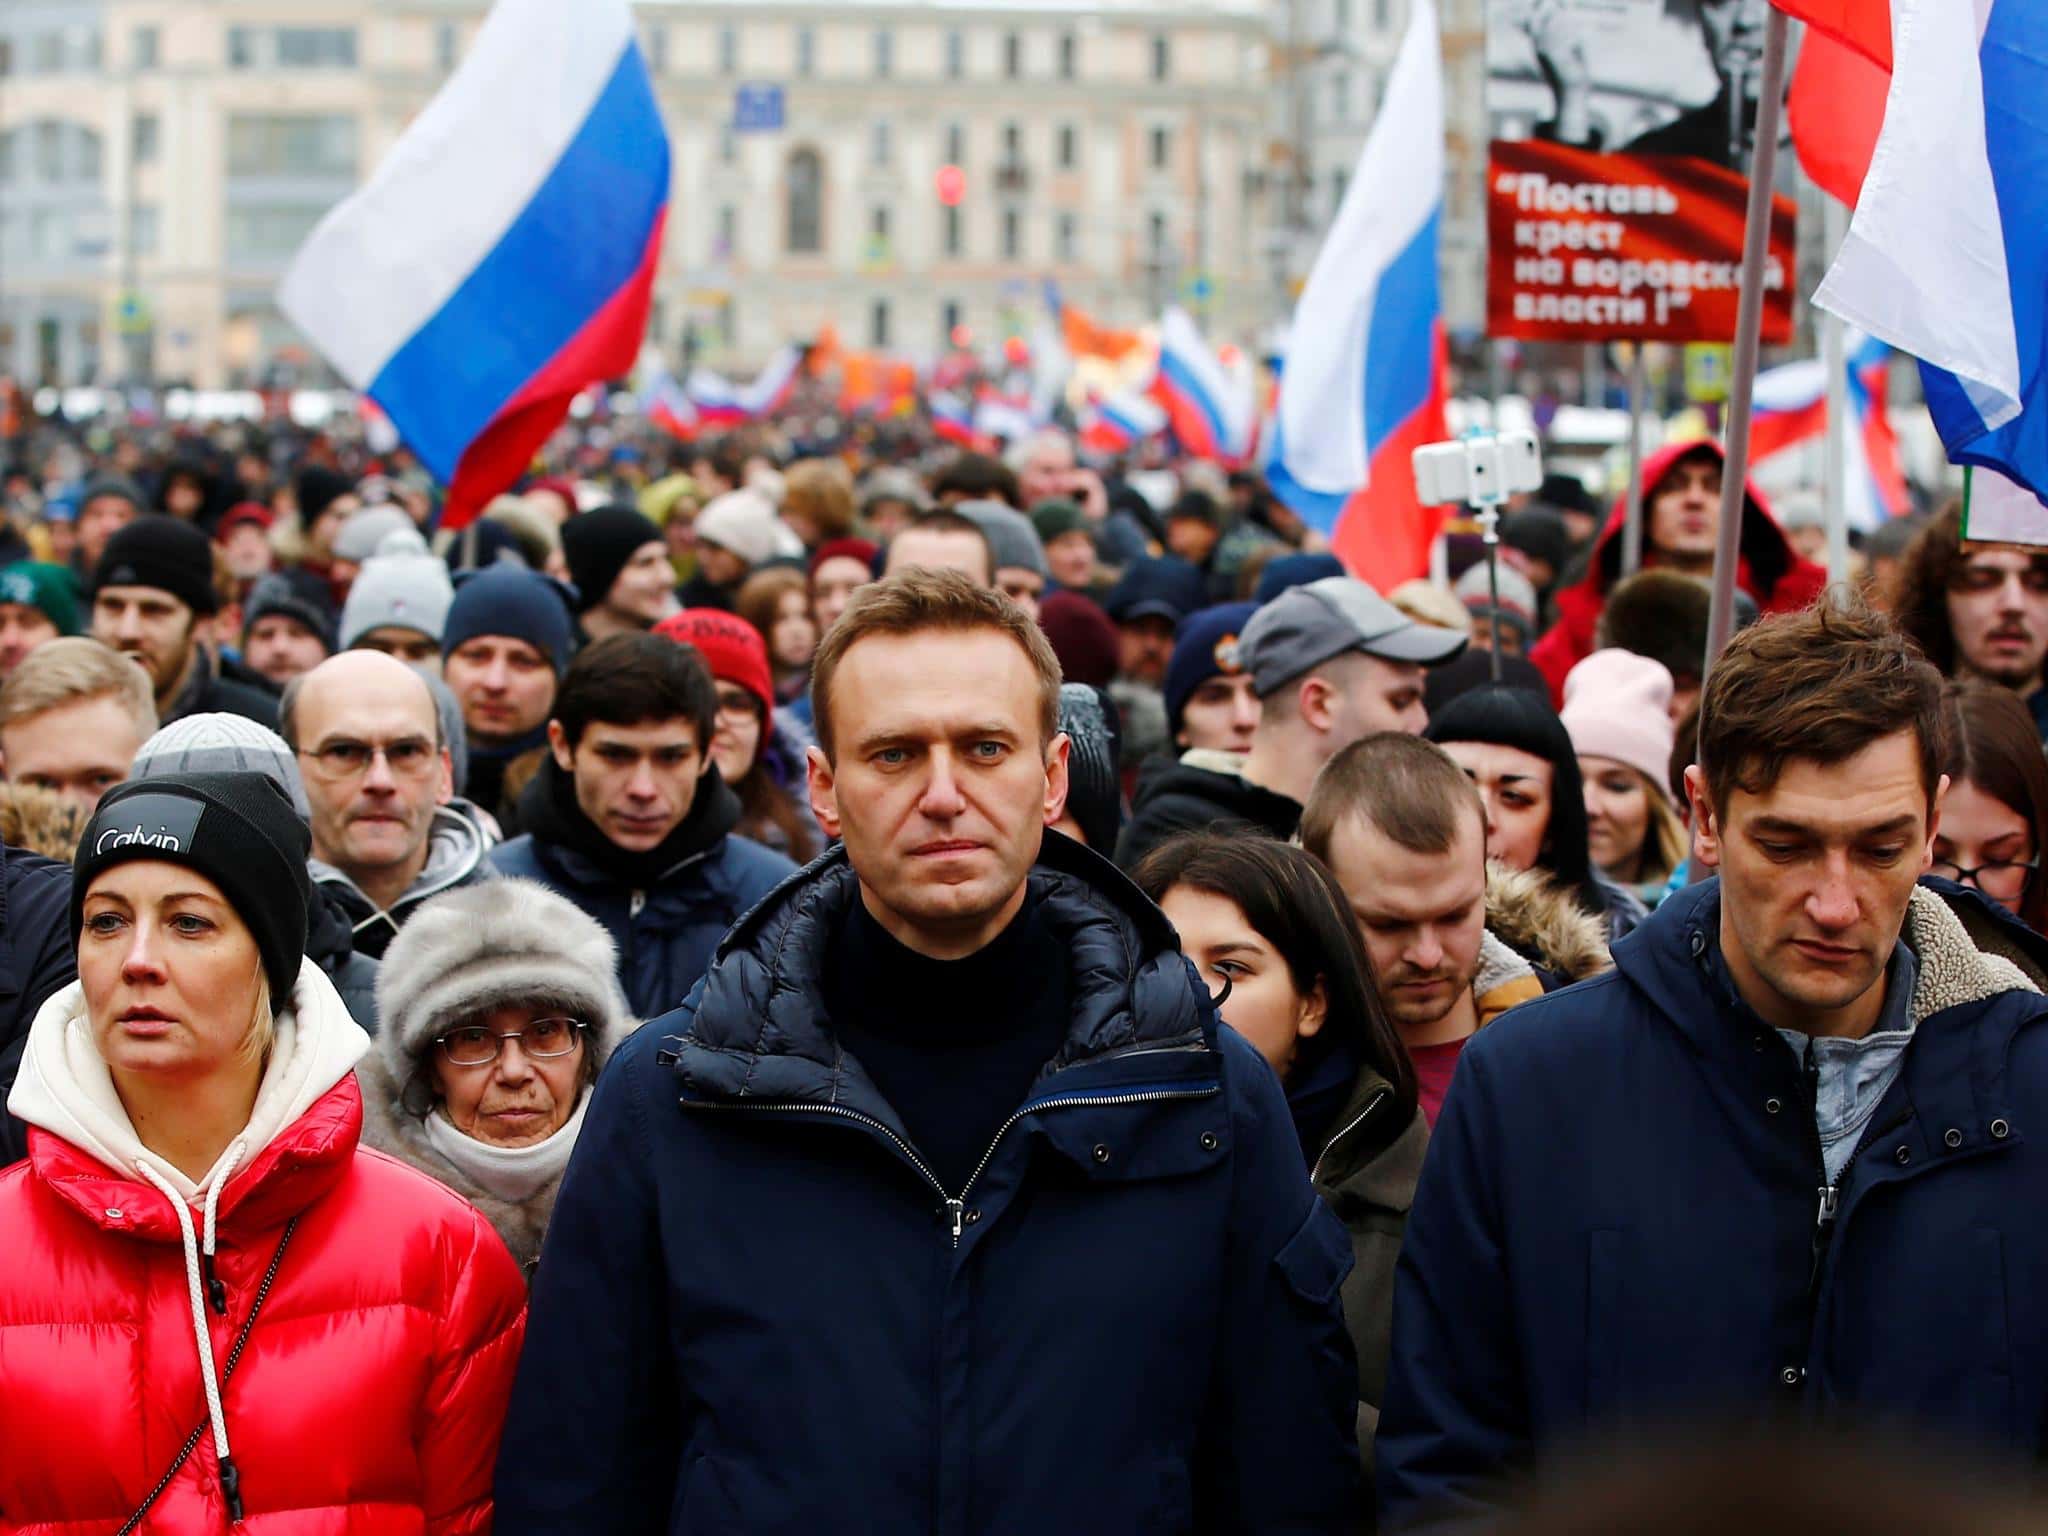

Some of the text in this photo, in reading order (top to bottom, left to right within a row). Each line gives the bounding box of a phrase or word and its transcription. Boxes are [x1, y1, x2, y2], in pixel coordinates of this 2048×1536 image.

[1514, 220, 1624, 255] крест
[1514, 258, 1564, 285] на
[1513, 293, 1646, 325] власти
[96, 825, 180, 855] Calvin
